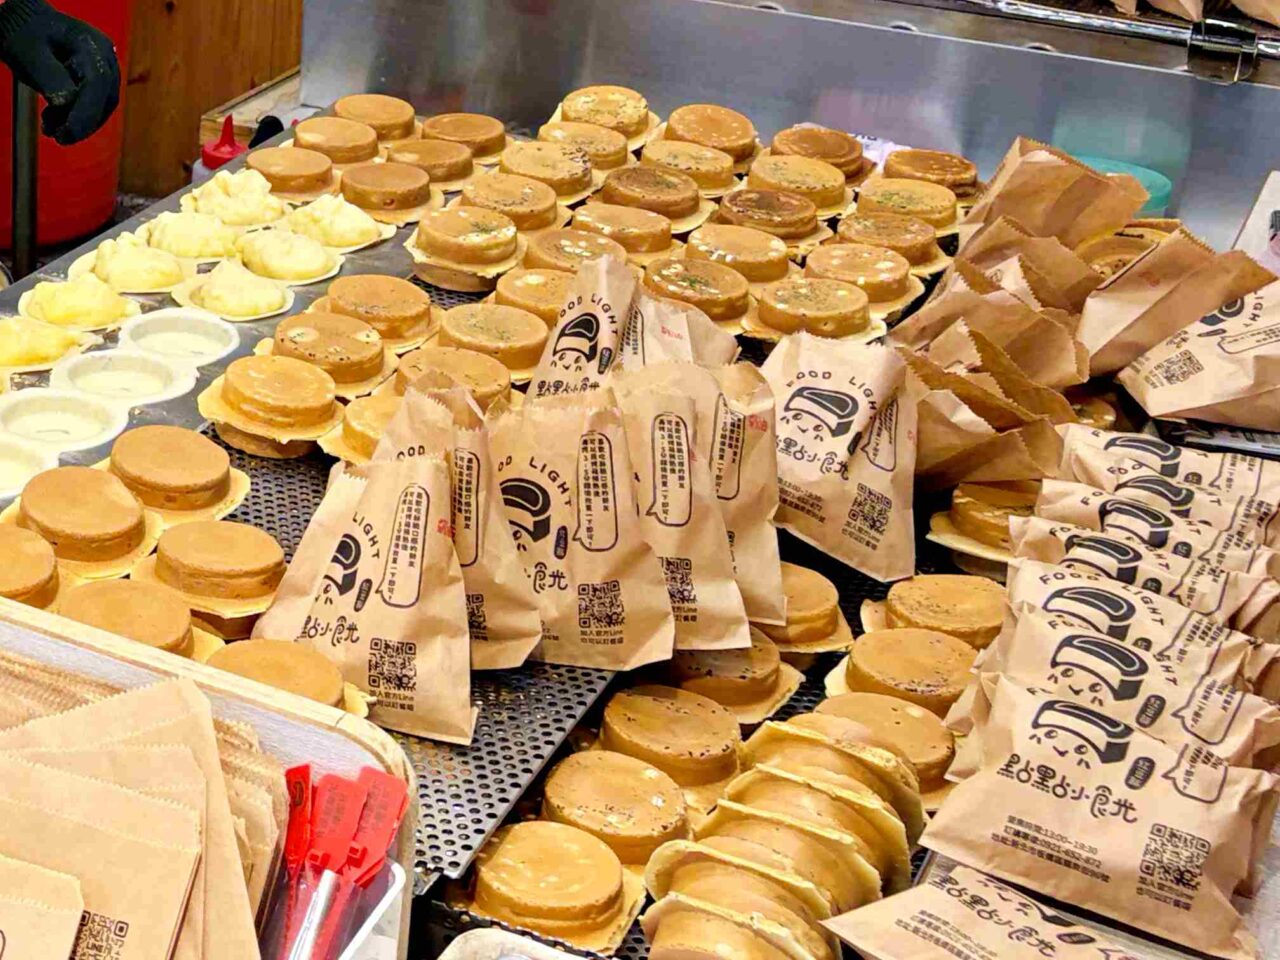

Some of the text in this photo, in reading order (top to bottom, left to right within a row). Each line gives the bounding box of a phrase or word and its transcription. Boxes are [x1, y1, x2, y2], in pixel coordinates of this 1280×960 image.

[591, 293, 618, 335] LIGHT
[528, 455, 573, 507] LIGHT
[352, 512, 381, 560] LIGHT
